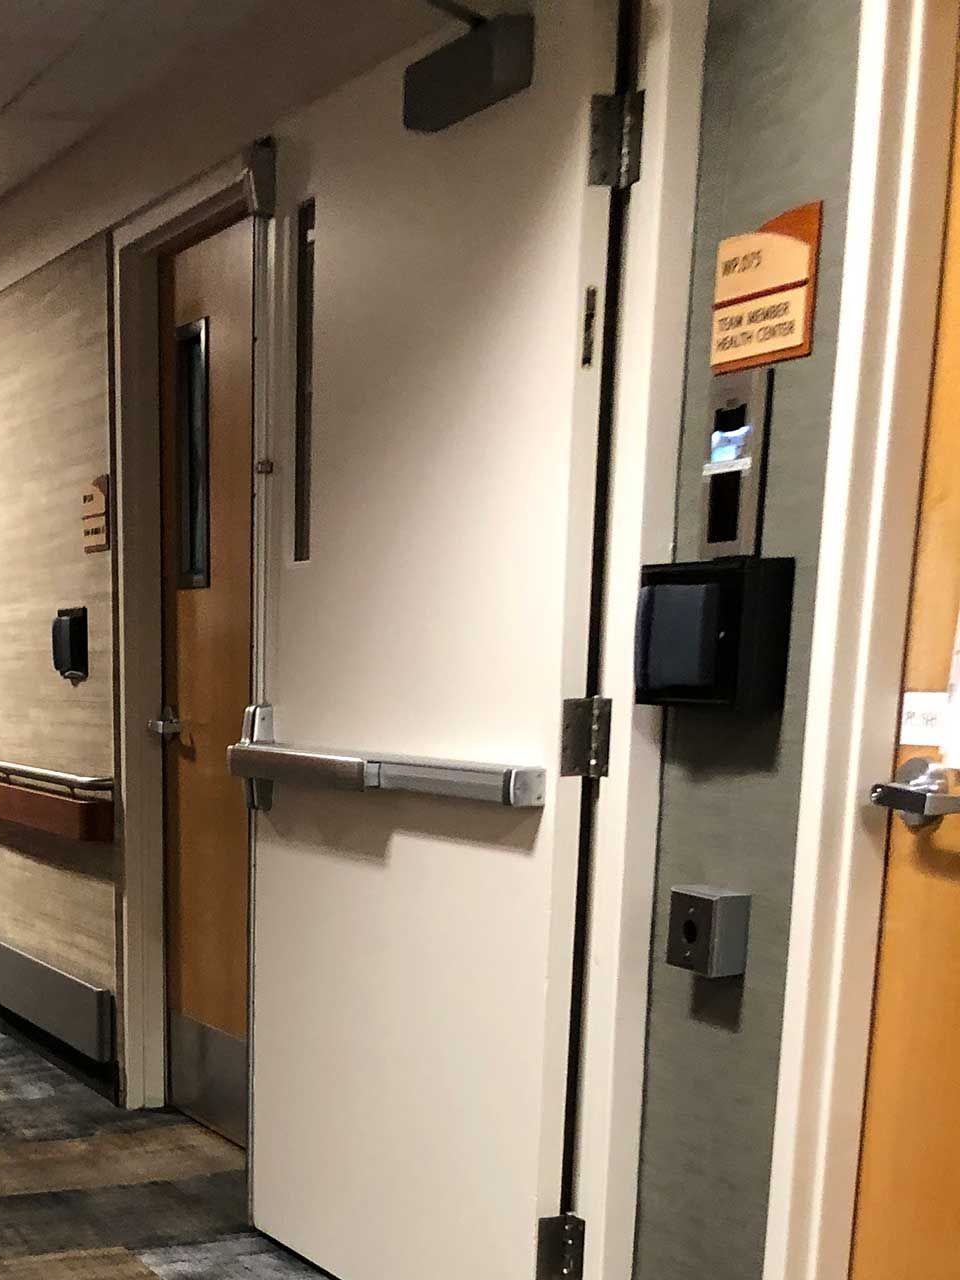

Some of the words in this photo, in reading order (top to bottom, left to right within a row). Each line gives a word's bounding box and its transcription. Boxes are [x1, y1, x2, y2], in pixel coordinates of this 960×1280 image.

[718, 315, 743, 332] TEAM
[748, 302, 790, 324] MEMBER
[716, 331, 753, 351] HEALTH
[757, 320, 795, 342] CENTER
